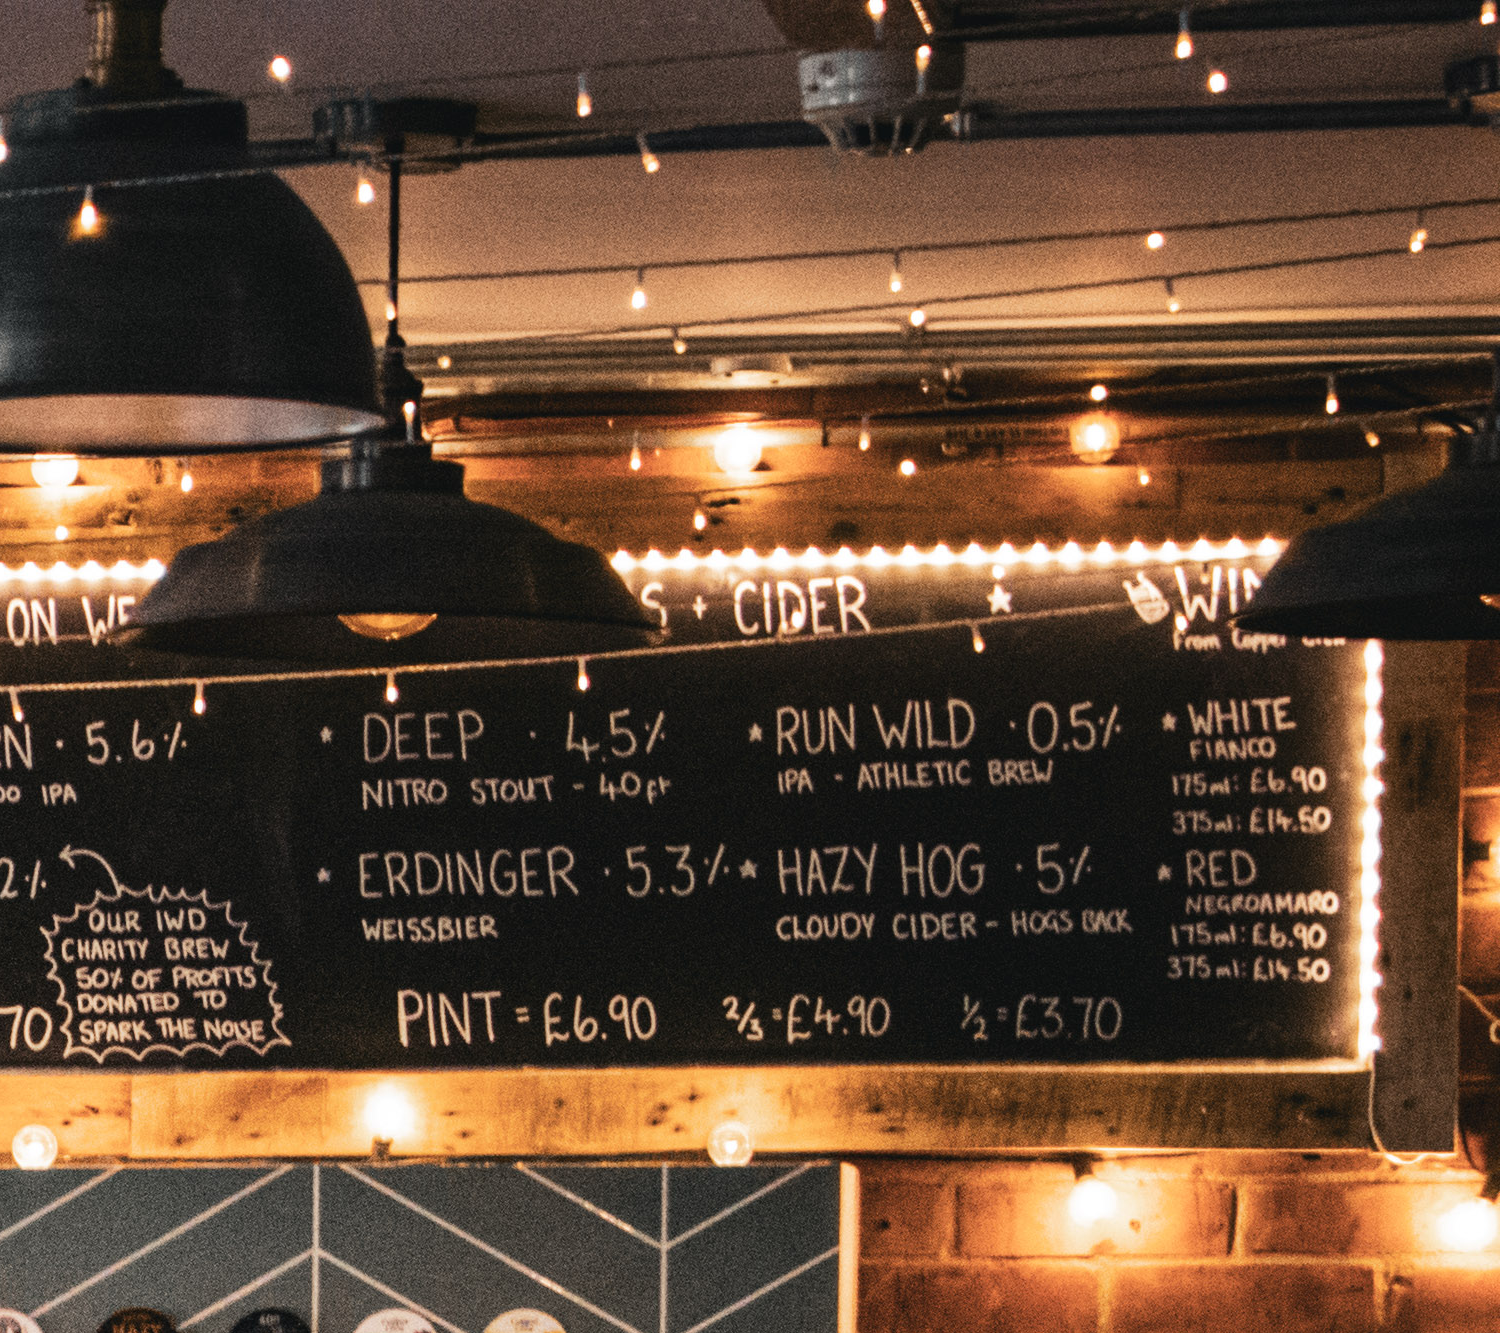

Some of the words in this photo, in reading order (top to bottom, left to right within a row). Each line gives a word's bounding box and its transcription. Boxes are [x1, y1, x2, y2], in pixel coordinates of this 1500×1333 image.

[6, 598, 58, 645] ON
[734, 574, 871, 636] CIDER
[775, 705, 856, 756] RUN
[872, 698, 976, 750] WILD
[1028, 701, 1122, 755] 0.5%
[1187, 696, 1297, 736] WHITE
[363, 709, 485, 763] DEEP
[566, 708, 666, 762] 4.5%
[361, 778, 448, 810] NITRO
[470, 775, 555, 805] STOUT
[599, 771, 673, 805] 40ft
[777, 767, 814, 794] IPA
[857, 759, 972, 791] ATHLETIC
[988, 759, 1054, 786] BREW
[1250, 765, 1327, 793] £6.90
[41, 783, 78, 806] IPA
[359, 845, 580, 900] ERDINGER
[626, 843, 731, 897] 5.3%
[776, 843, 878, 897] HAZY
[900, 842, 985, 898] HOG
[1036, 842, 1092, 894] 5%
[1186, 849, 1257, 888] RED
[1185, 890, 1339, 915] NEGROAMARO
[88, 908, 142, 934] OUR
[156, 908, 207, 933] IWD
[362, 915, 499, 942] WEISSBIER
[775, 912, 876, 940] CLOUDY
[892, 911, 977, 940] CIDER
[1011, 909, 1074, 935] HOGS
[1082, 908, 1133, 935] BACK
[1252, 922, 1327, 950] £6.90
[61, 937, 149, 963] CHARITY
[164, 936, 229, 961] BREW
[75, 966, 123, 989] 50%
[131, 968, 162, 990] OF
[172, 965, 256, 989] PROFITS
[77, 991, 180, 1014] DONATED
[193, 989, 227, 1010] TO
[78, 1019, 152, 1044] SPARK
[155, 1017, 197, 1040] THE
[203, 1018, 265, 1042] NOISE
[397, 990, 501, 1048] PINT
[544, 992, 657, 1047] £6.90
[787, 994, 892, 1044] £4.90
[1015, 995, 1123, 1042] £3.70
